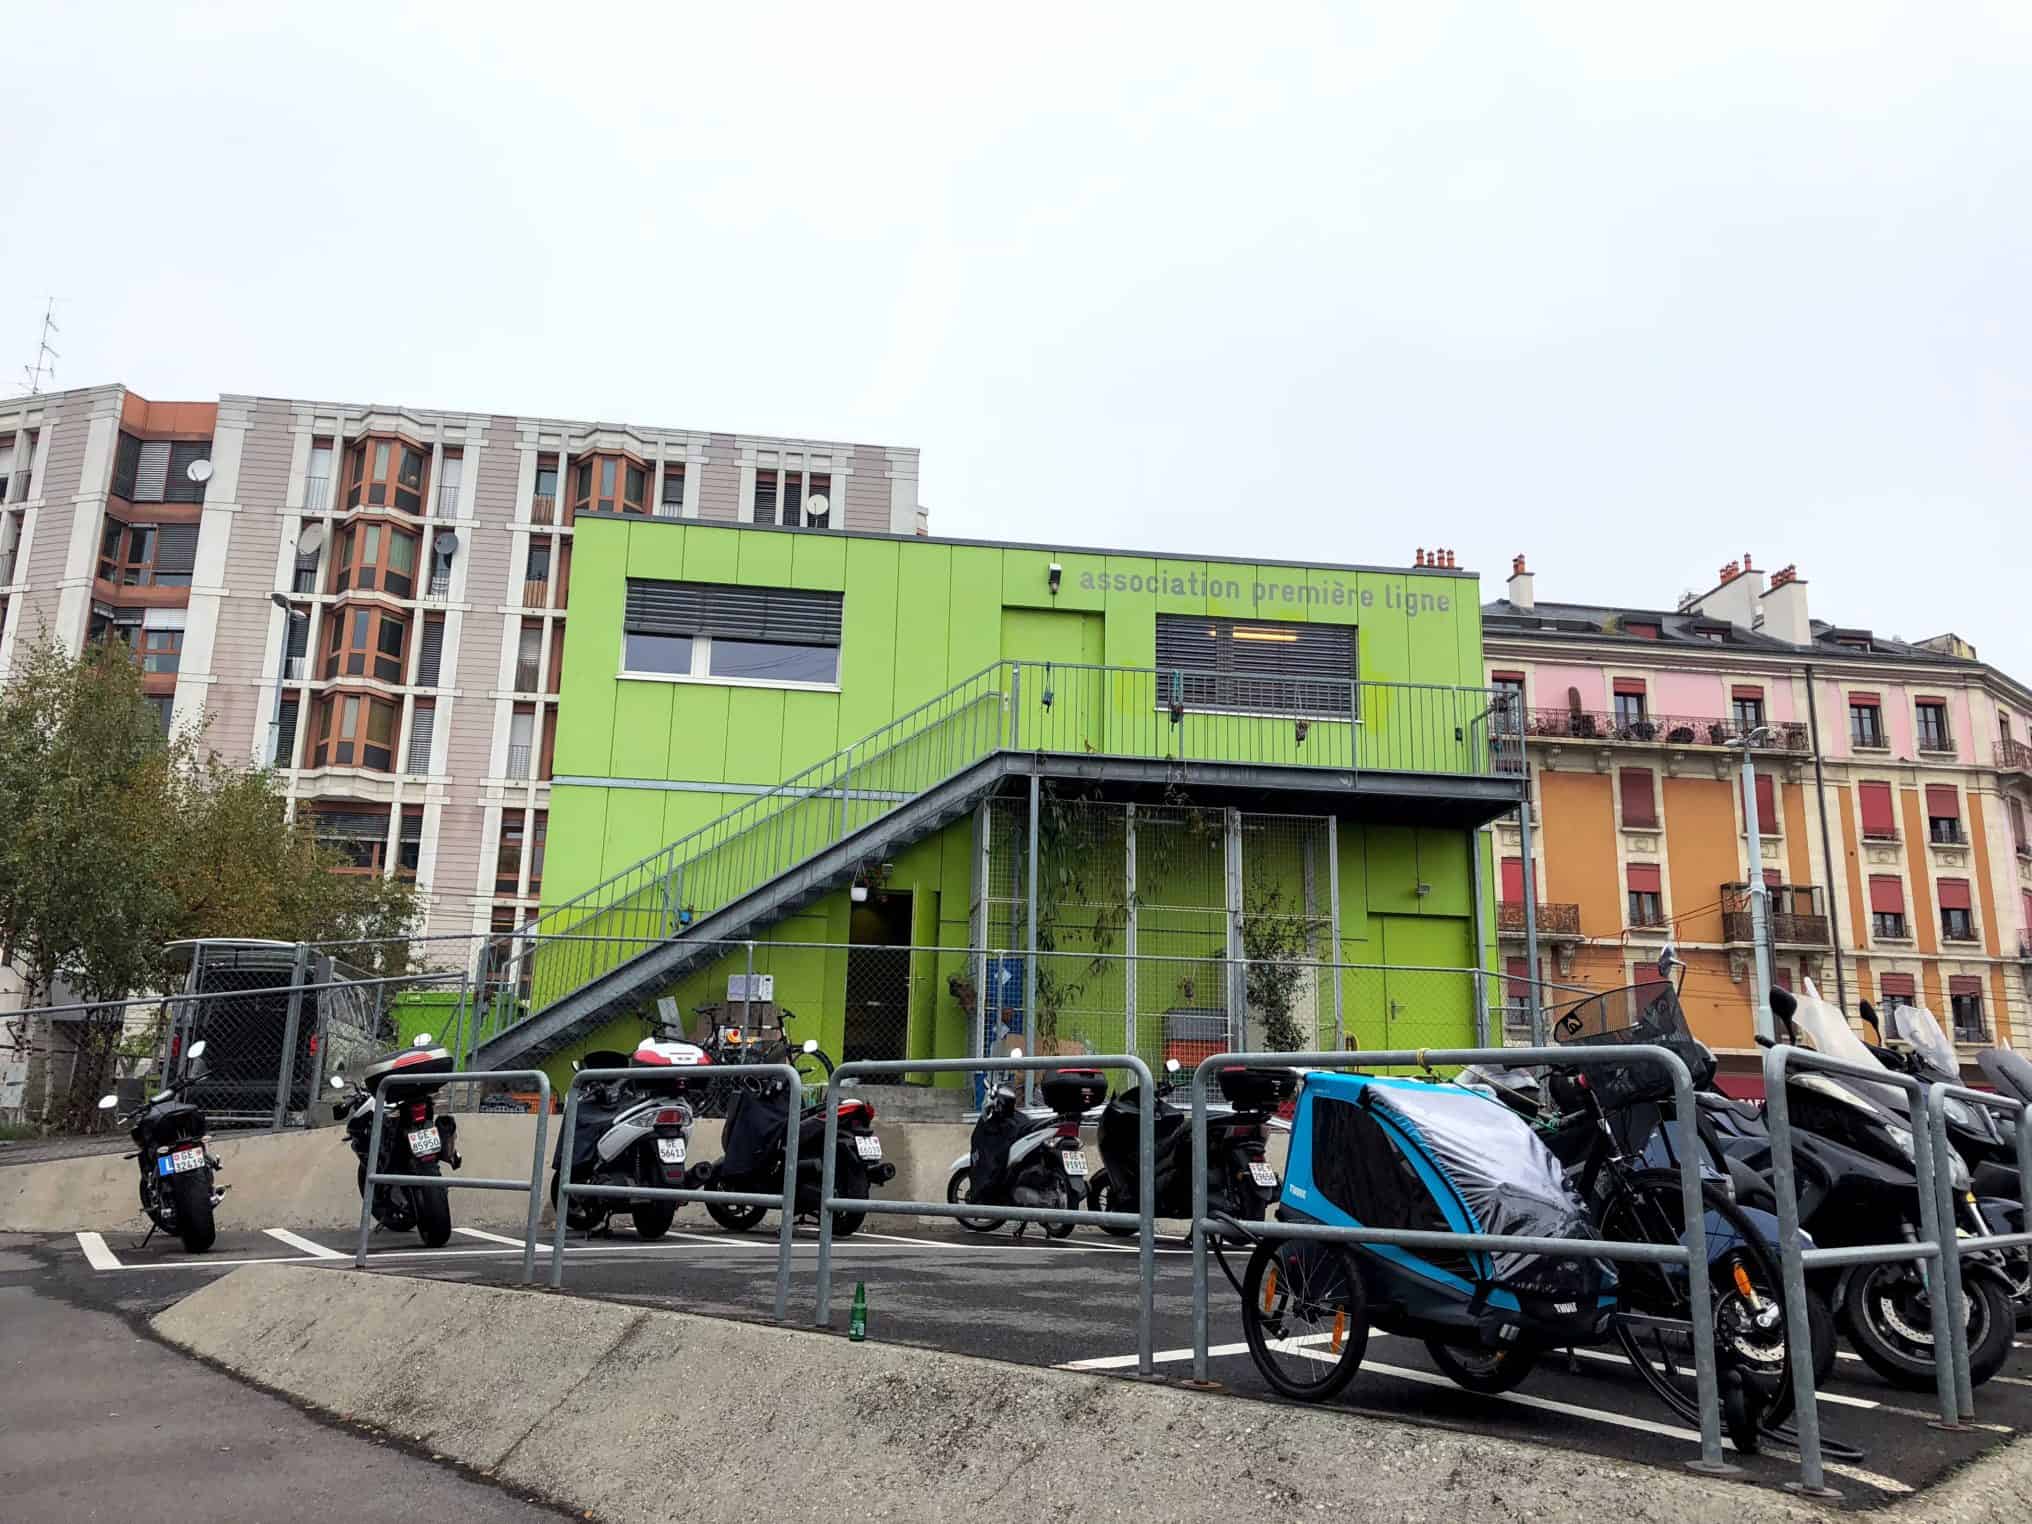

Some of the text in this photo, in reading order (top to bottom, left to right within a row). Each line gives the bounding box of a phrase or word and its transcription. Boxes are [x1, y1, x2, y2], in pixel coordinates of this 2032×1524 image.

[1079, 569, 1450, 616] association première ligne
[181, 1151, 194, 1161] GE
[166, 1158, 174, 1171] L
